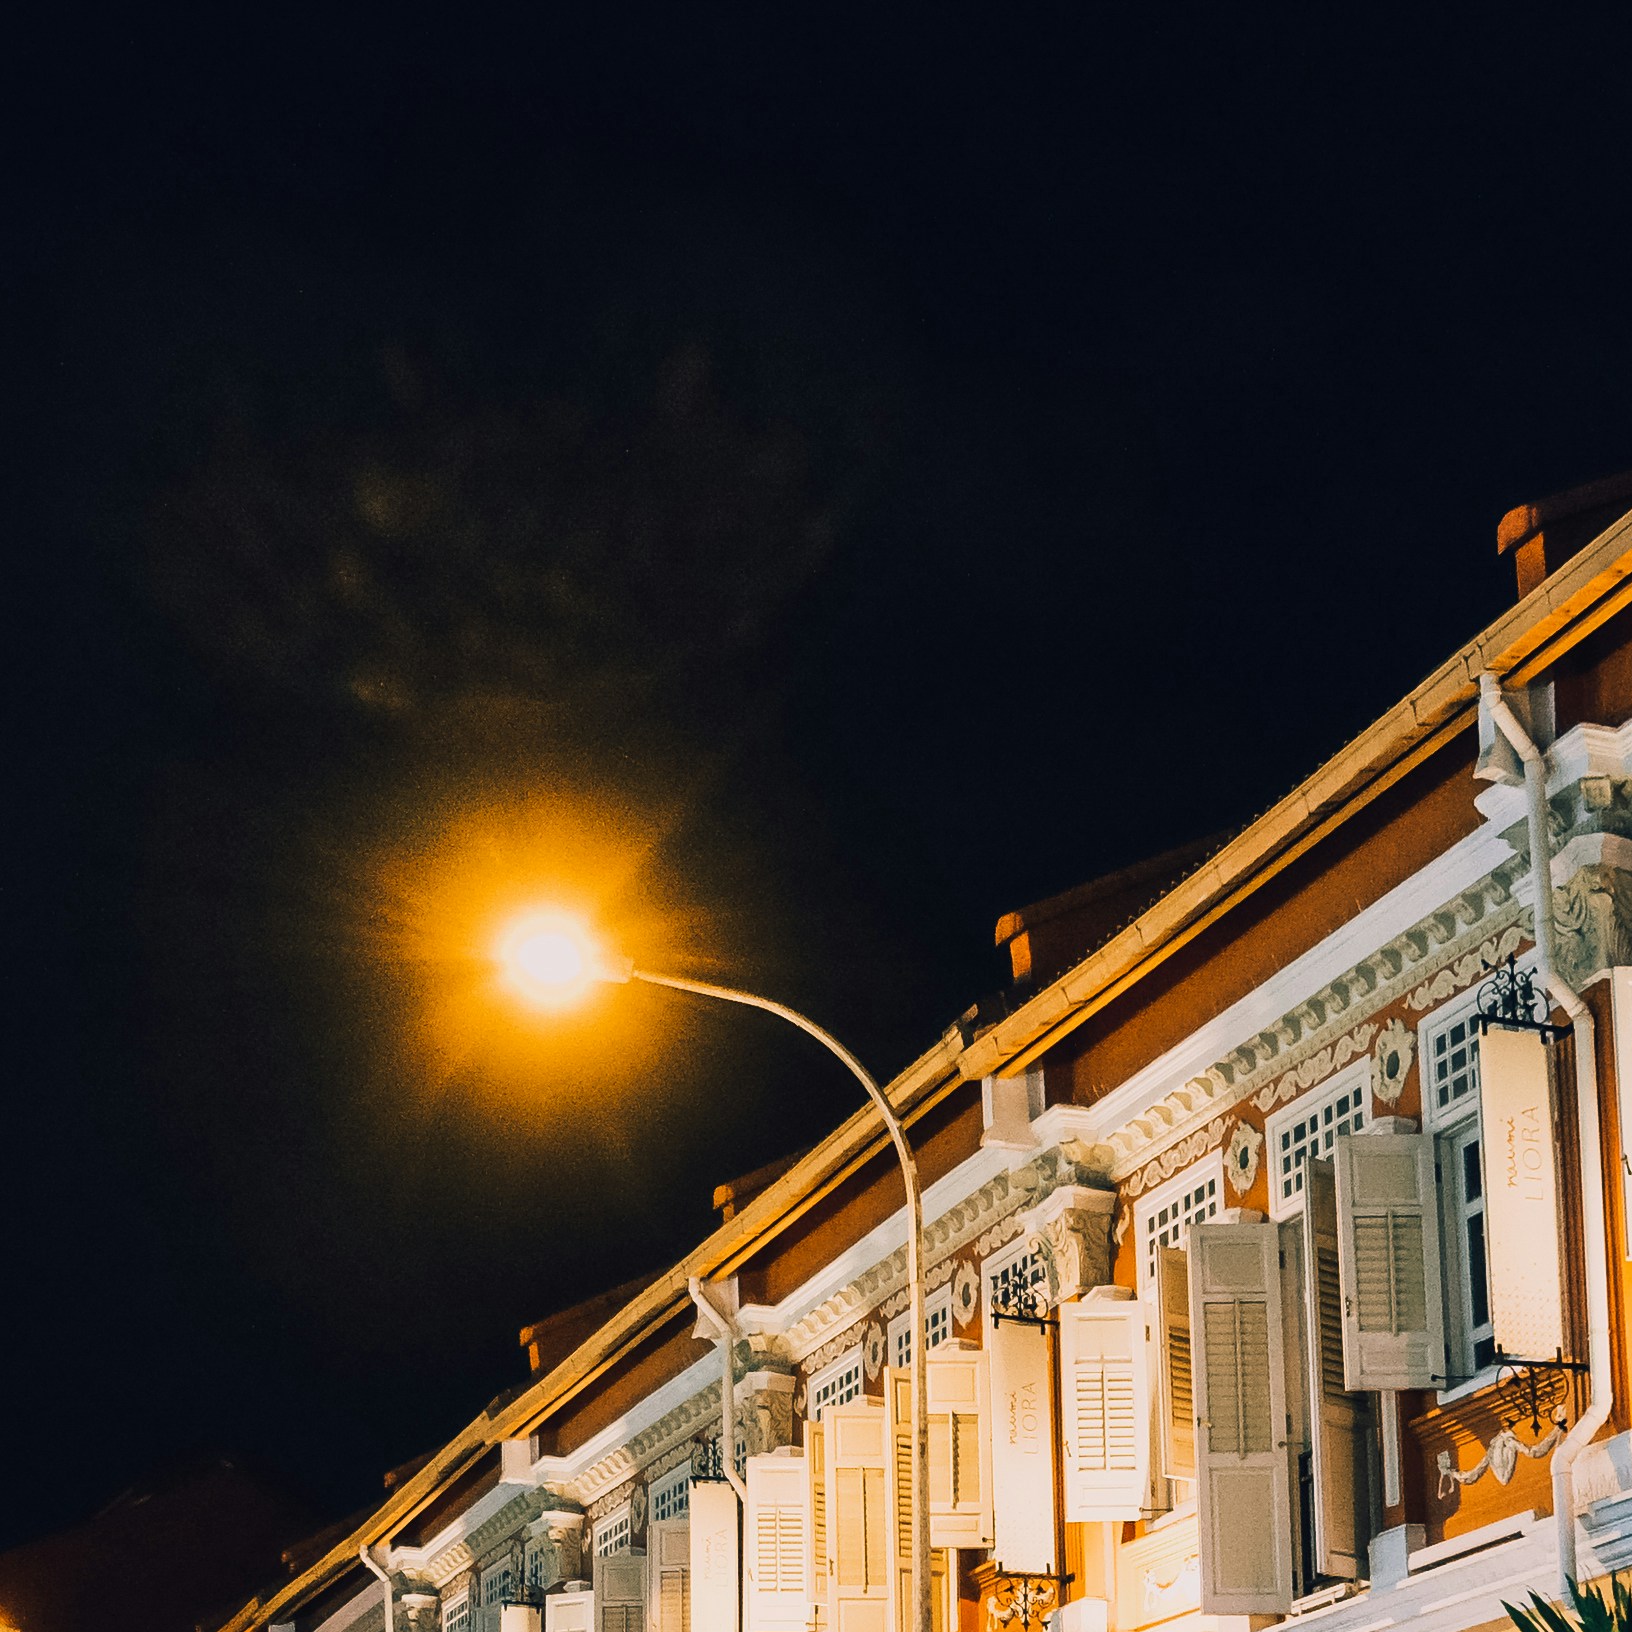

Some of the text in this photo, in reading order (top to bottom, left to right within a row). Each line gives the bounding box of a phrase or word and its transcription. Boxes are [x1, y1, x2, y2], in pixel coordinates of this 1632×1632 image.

[1499, 1116, 1518, 1188] naumi
[1521, 1105, 1544, 1200] LIORA
[1021, 1382, 1038, 1454] LIORA
